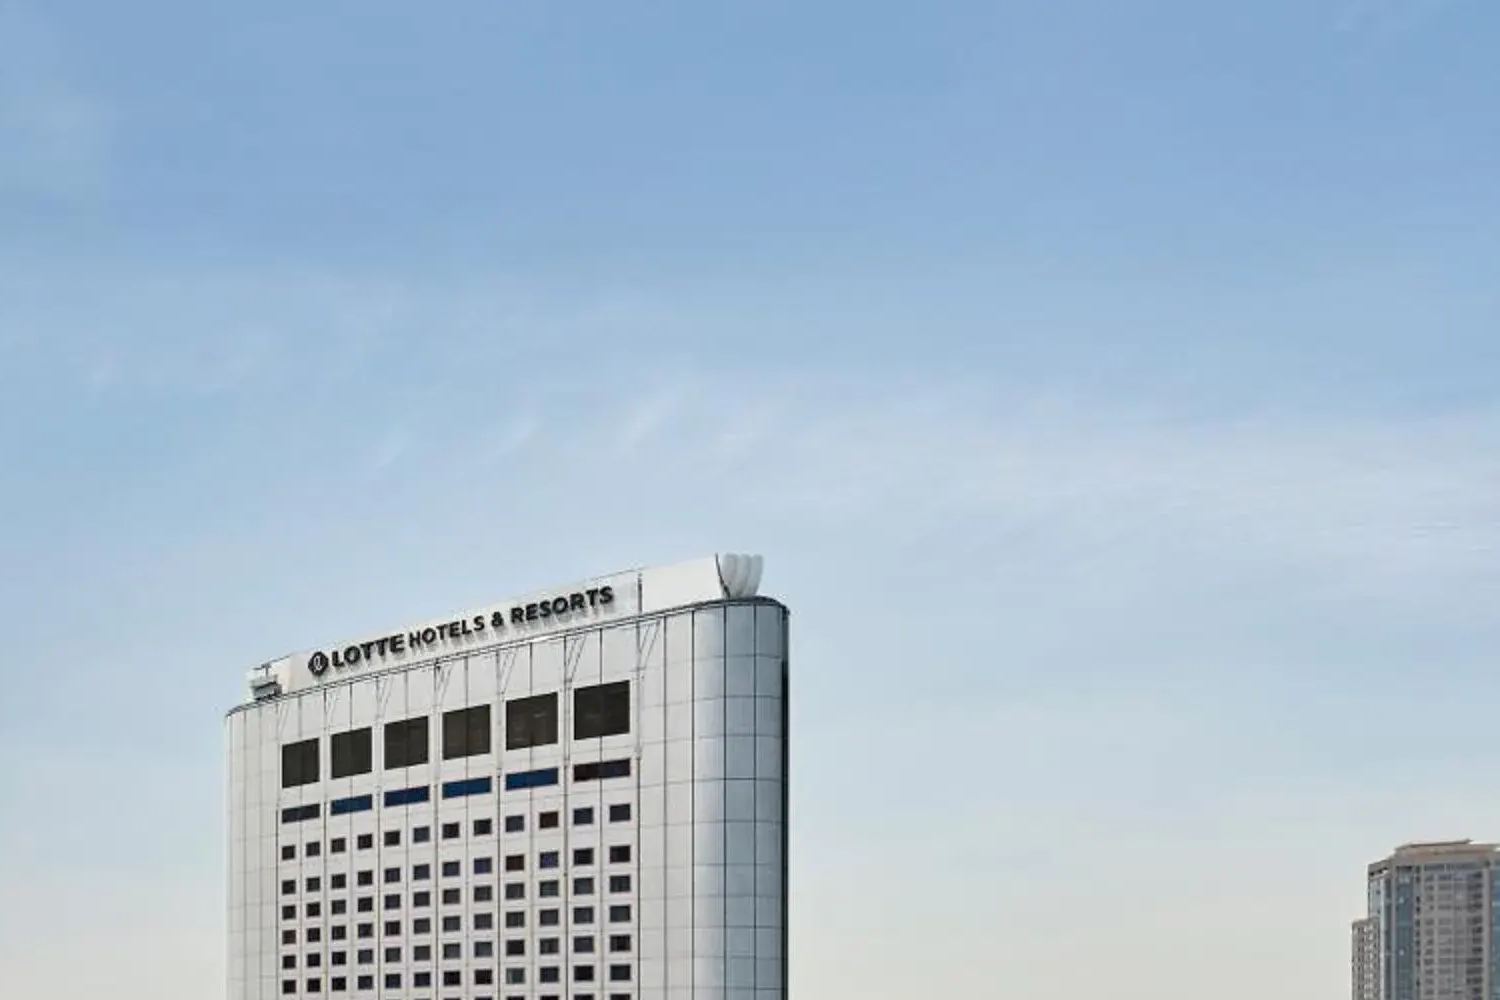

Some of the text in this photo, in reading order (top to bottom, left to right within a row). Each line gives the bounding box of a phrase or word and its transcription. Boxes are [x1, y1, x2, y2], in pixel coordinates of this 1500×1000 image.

[330, 585, 615, 667] LOTTE HOTELS & RESORTS
